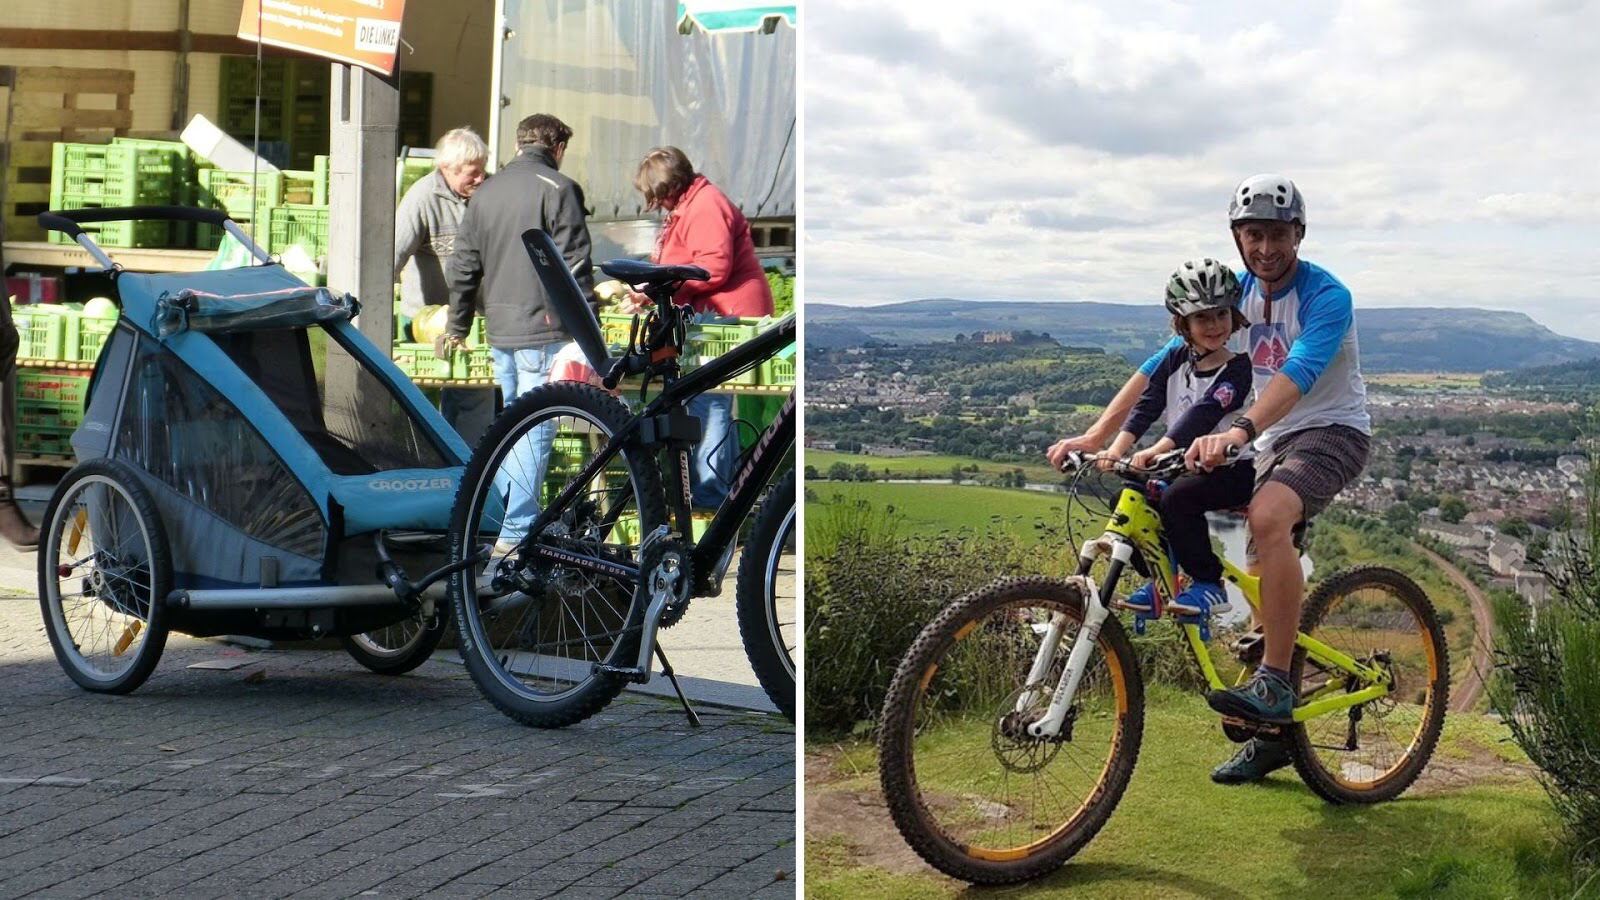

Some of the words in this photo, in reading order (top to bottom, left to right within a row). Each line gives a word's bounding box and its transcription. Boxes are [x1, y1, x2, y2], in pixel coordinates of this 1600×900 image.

[360, 25, 374, 44] DIE
[367, 477, 453, 491] CROOZER
[539, 547, 594, 568] HANDMADE
[596, 562, 606, 570] IN
[608, 566, 627, 576] USA
